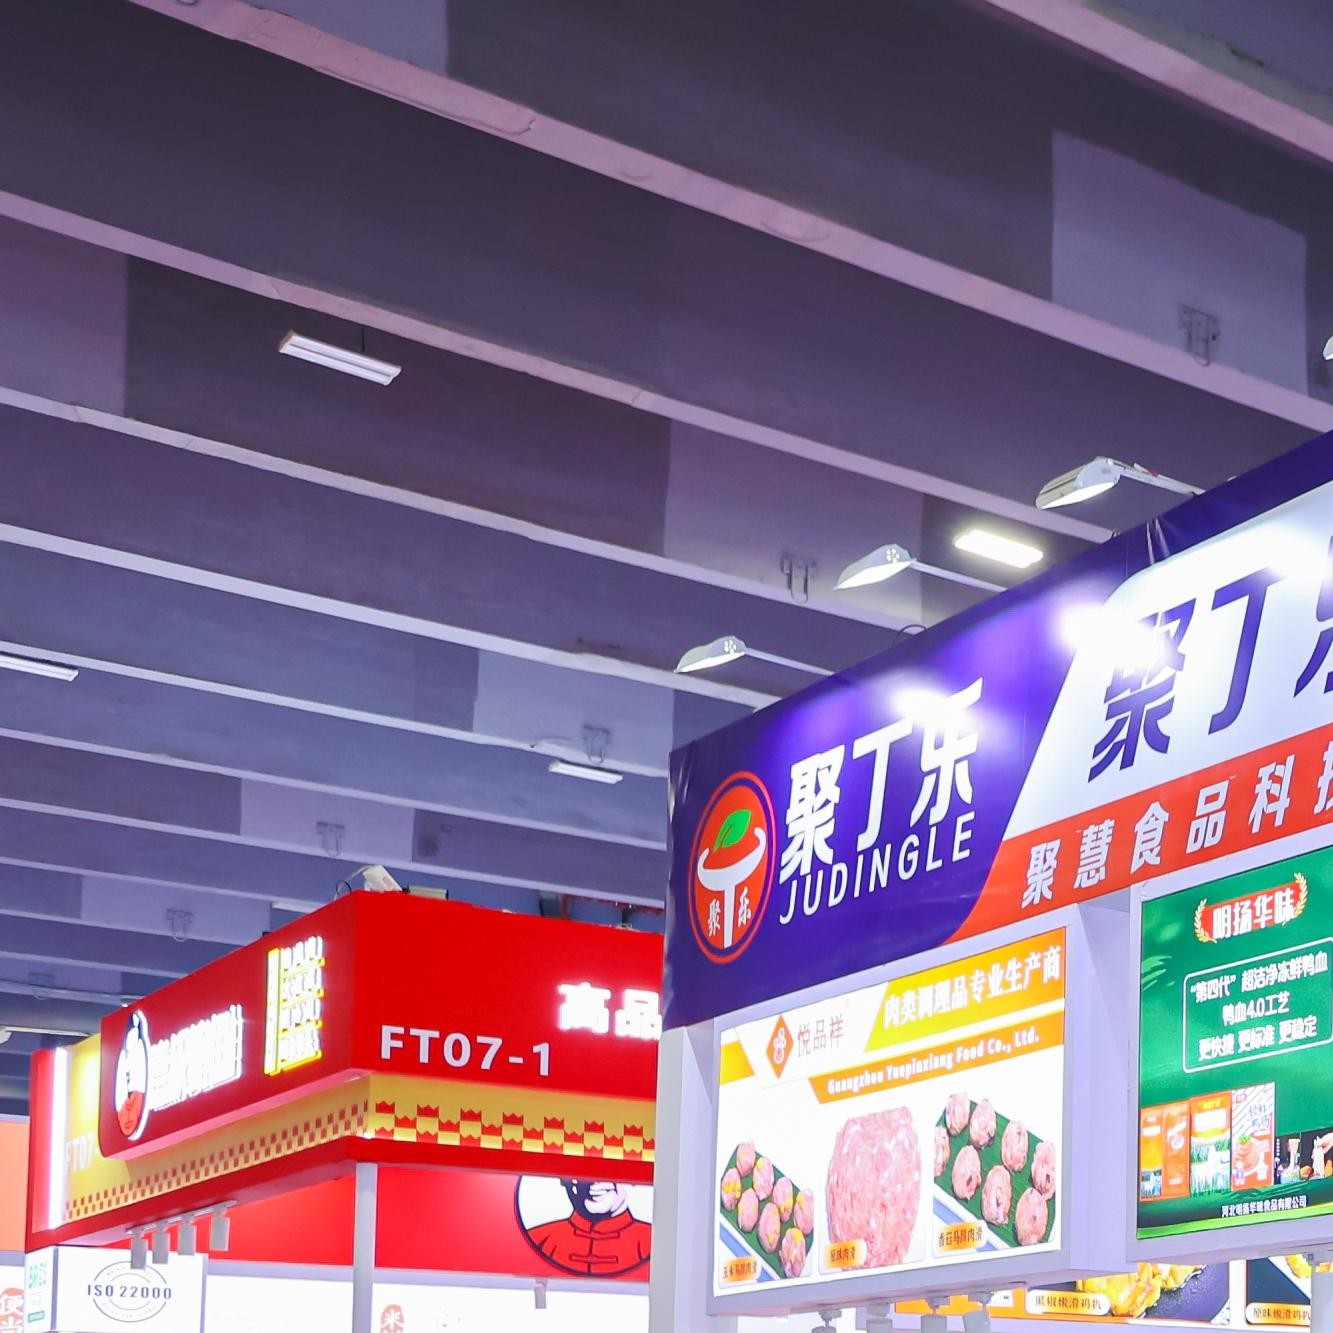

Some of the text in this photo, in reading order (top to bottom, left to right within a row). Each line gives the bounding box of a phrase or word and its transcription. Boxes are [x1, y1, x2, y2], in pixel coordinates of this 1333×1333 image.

[779, 677, 983, 885] 聚丁乐
[779, 811, 976, 924] JUDINGLE
[1211, 887, 1296, 941] 明扬华味
[884, 945, 1061, 1029] 肉类调理品专业生产商
[1222, 991, 1290, 1027] 鸭血4.0工艺
[380, 1024, 551, 1077] FT07-1
[827, 1066, 884, 1096] Guangzhou
[956, 1041, 984, 1065] Food
[1014, 1025, 1040, 1049] Ltd.
[1221, 1195, 1308, 1218] 河北明扬华味食品有限公司
[87, 1284, 172, 1300] ISO 22000
